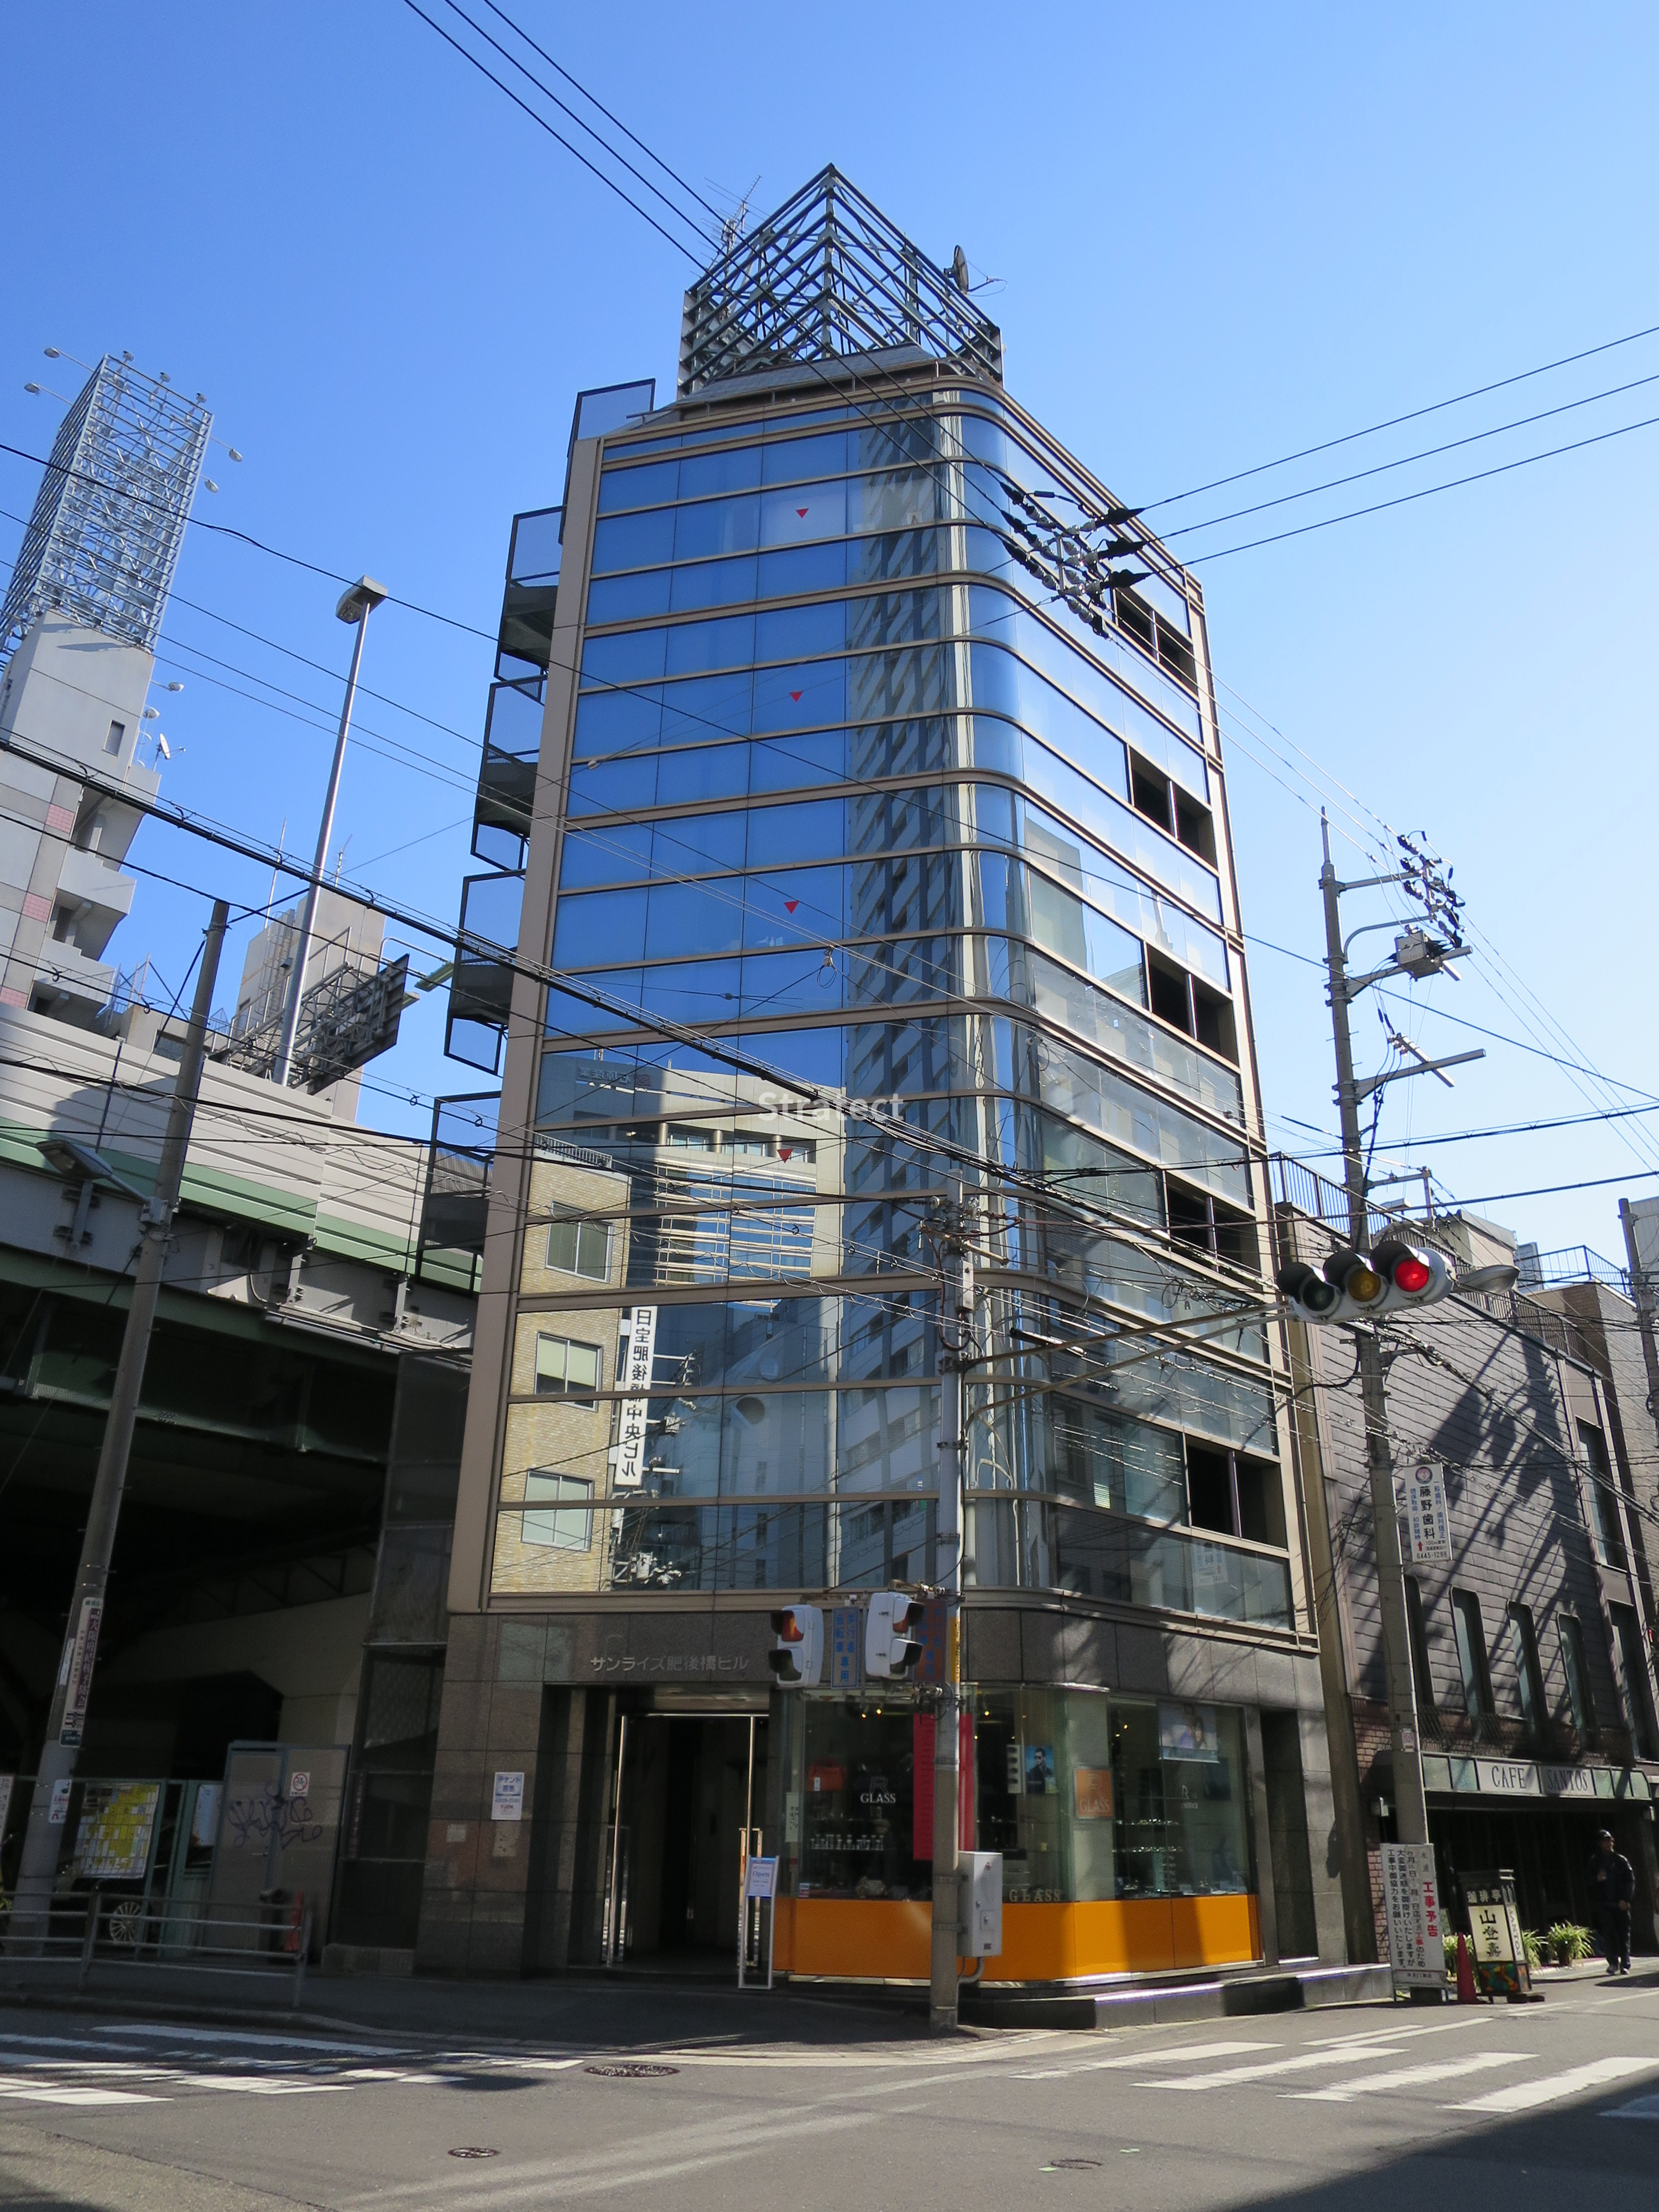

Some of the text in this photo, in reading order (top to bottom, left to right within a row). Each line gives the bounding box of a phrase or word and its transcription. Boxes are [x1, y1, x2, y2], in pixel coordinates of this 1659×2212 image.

[1420, 1485, 1435, 1540] 藤野歯科
[590, 1655, 749, 1672] サンライズ肥後橋ビル
[841, 1656, 849, 1681] 専用
[1491, 1765, 1588, 1791] CAFE SANTOS
[860, 1794, 896, 1803] GLASS
[1080, 1799, 1110, 1813] GLASS
[1009, 1888, 1061, 1902] GLASS
[1423, 1882, 1438, 1938] 工事予告
[1508, 1908, 1522, 1957] SANTOS
